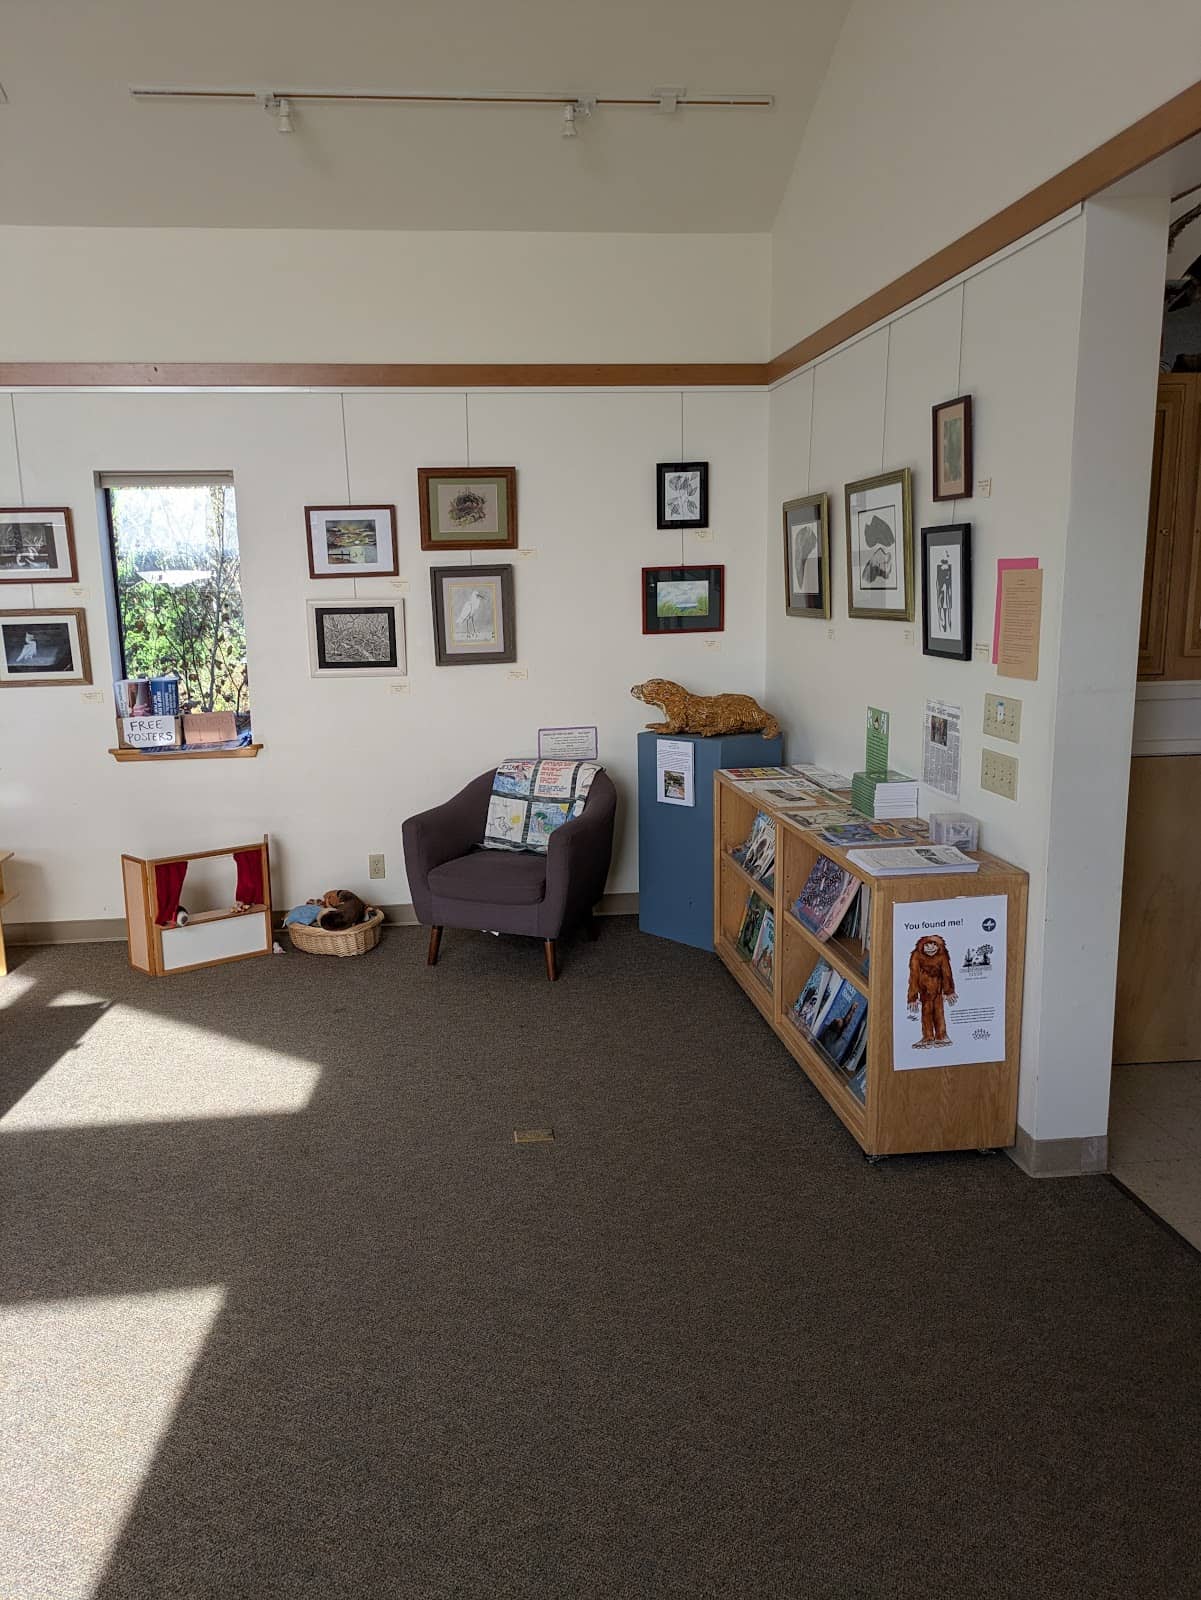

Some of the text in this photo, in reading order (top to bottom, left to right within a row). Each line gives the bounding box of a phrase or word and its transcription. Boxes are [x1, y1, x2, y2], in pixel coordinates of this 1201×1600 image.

[130, 720, 162, 731] FREE
[127, 731, 173, 743] POSTERS
[922, 920, 946, 929] found
[948, 919, 964, 927] me!
